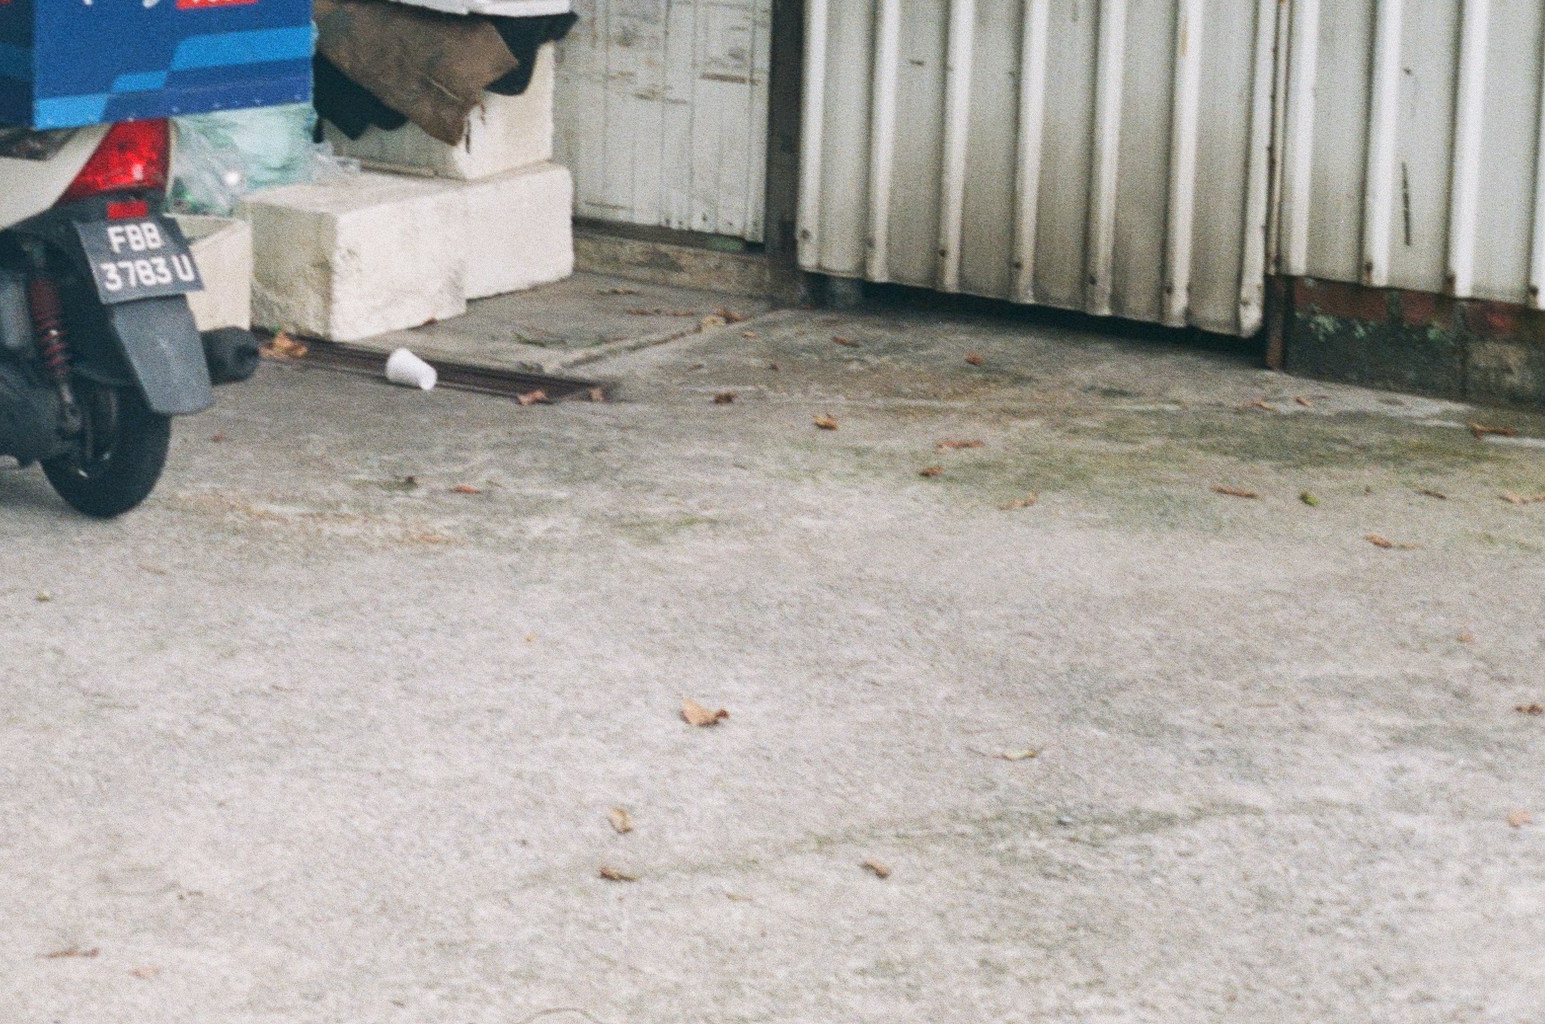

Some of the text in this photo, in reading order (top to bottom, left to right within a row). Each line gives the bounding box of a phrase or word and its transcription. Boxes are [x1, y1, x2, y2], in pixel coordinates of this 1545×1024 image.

[107, 221, 162, 253] FBB
[100, 254, 195, 291] 3783 U
